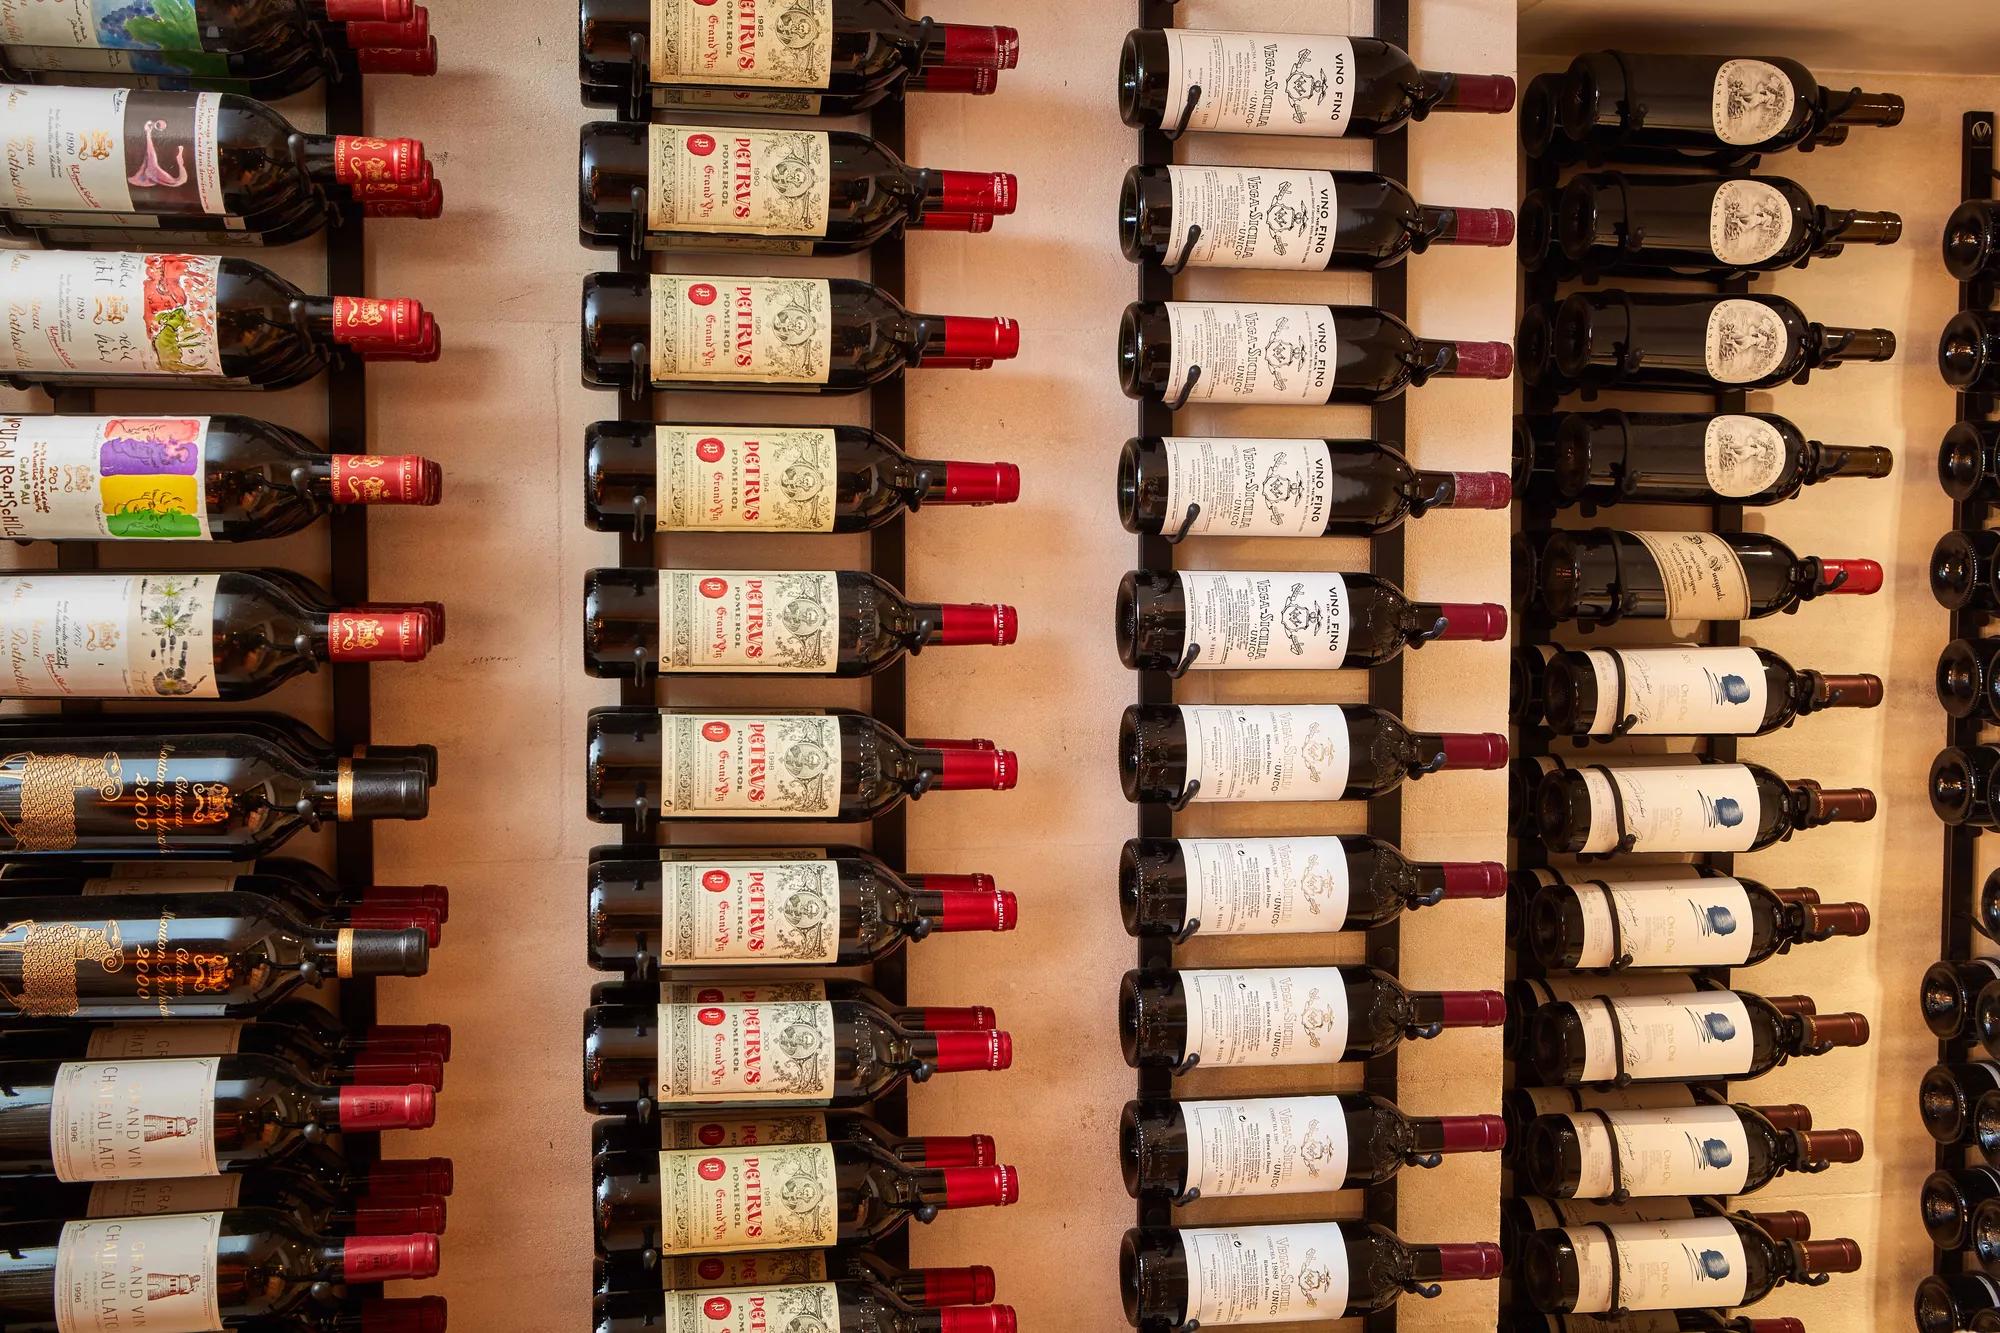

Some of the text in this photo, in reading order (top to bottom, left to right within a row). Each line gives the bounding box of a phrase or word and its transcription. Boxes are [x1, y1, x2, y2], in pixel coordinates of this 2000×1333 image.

[704, 15, 719, 72] Grand Vin
[726, 0, 734, 58] OMEROL
[737, 0, 756, 71] ETRVS
[1256, 44, 1278, 129] VEGA-SICILIA
[1330, 53, 1344, 121] VINO FINO
[1716, 60, 1736, 142] HARLAN ESTATE
[66, 132, 75, 156] 1990
[700, 165, 716, 218] Grand Vin
[1242, 176, 1263, 258] VEGA-SICILIA
[1315, 188, 1328, 254] VINO FINO
[1712, 182, 1735, 262] HARLAN ESTATE
[76, 297, 86, 320] 1989
[702, 314, 718, 368] Grand Vin
[1242, 312, 1262, 395] VEGA-SICILIA
[1314, 323, 1326, 388] VINO FINO
[1706, 303, 1729, 382] HARLAN ESTATE
[405, 461, 411, 470] AU
[732, 448, 740, 512] POMEROL
[1706, 417, 1726, 492] HARLAN ESTATE
[710, 471, 724, 522] Grand Vin
[1239, 447, 1259, 529] VEGA-SICILIA
[1311, 458, 1324, 522] VINO FINO
[712, 607, 728, 660] Grand Vin
[998, 619, 1004, 628] AU
[1254, 579, 1274, 660] VEGA-SICILIA
[1329, 586, 1339, 652] VINO FINO
[156, 744, 177, 789] Mouton
[714, 750, 730, 802] Grand Vin
[135, 773, 150, 830] 2000
[174, 776, 189, 828] Château
[715, 900, 730, 952] Grand Vin
[998, 894, 1002, 902] AU
[157, 905, 177, 962] Mouton
[136, 944, 150, 1000] 2000
[176, 948, 190, 999] Château
[712, 1033, 726, 1086] Grand Vin
[116, 1122, 122, 1136] DE
[129, 1146, 143, 1169] VIN
[712, 1189, 727, 1240] Grand Vin
[732, 1166, 740, 1228] POMEROL
[74, 1282, 82, 1303] 1996
[101, 1224, 122, 1329] CHATEAU LATO
[120, 1282, 126, 1295] DE
[749, 1296, 766, 1333] PET
